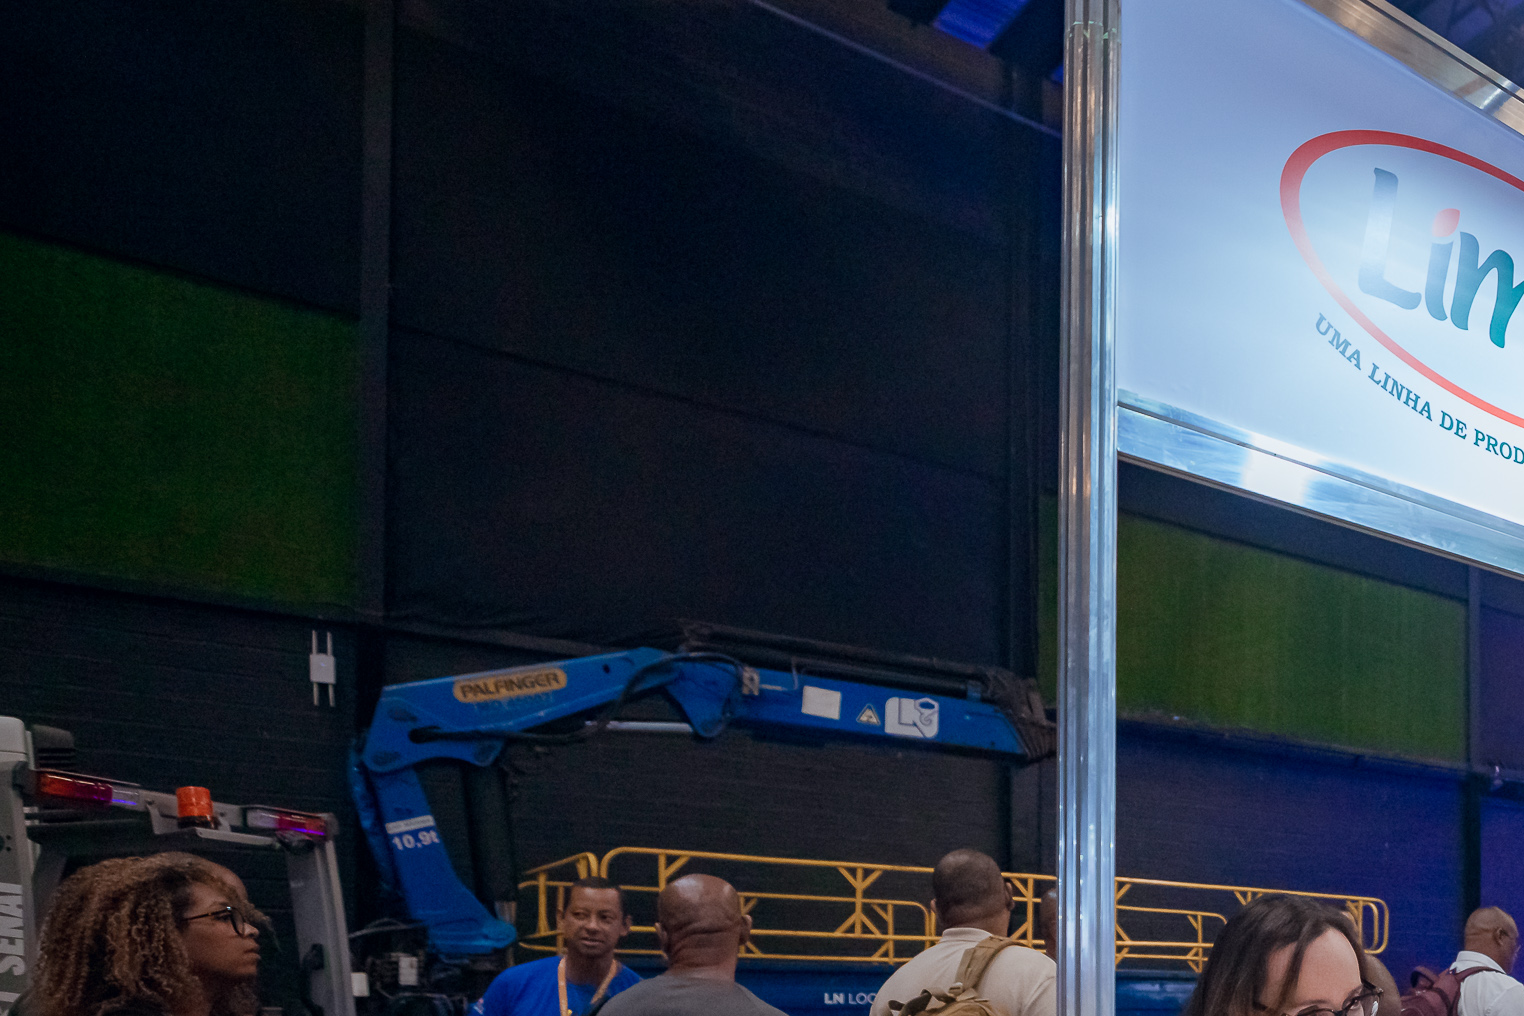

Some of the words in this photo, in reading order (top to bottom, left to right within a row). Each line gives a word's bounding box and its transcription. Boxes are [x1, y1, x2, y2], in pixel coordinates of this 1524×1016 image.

[1315, 313, 1362, 371] UMA
[1368, 362, 1433, 422] LINHA
[1439, 410, 1467, 440] DE
[459, 672, 560, 698] PALFINGER
[824, 992, 845, 1005] LN
